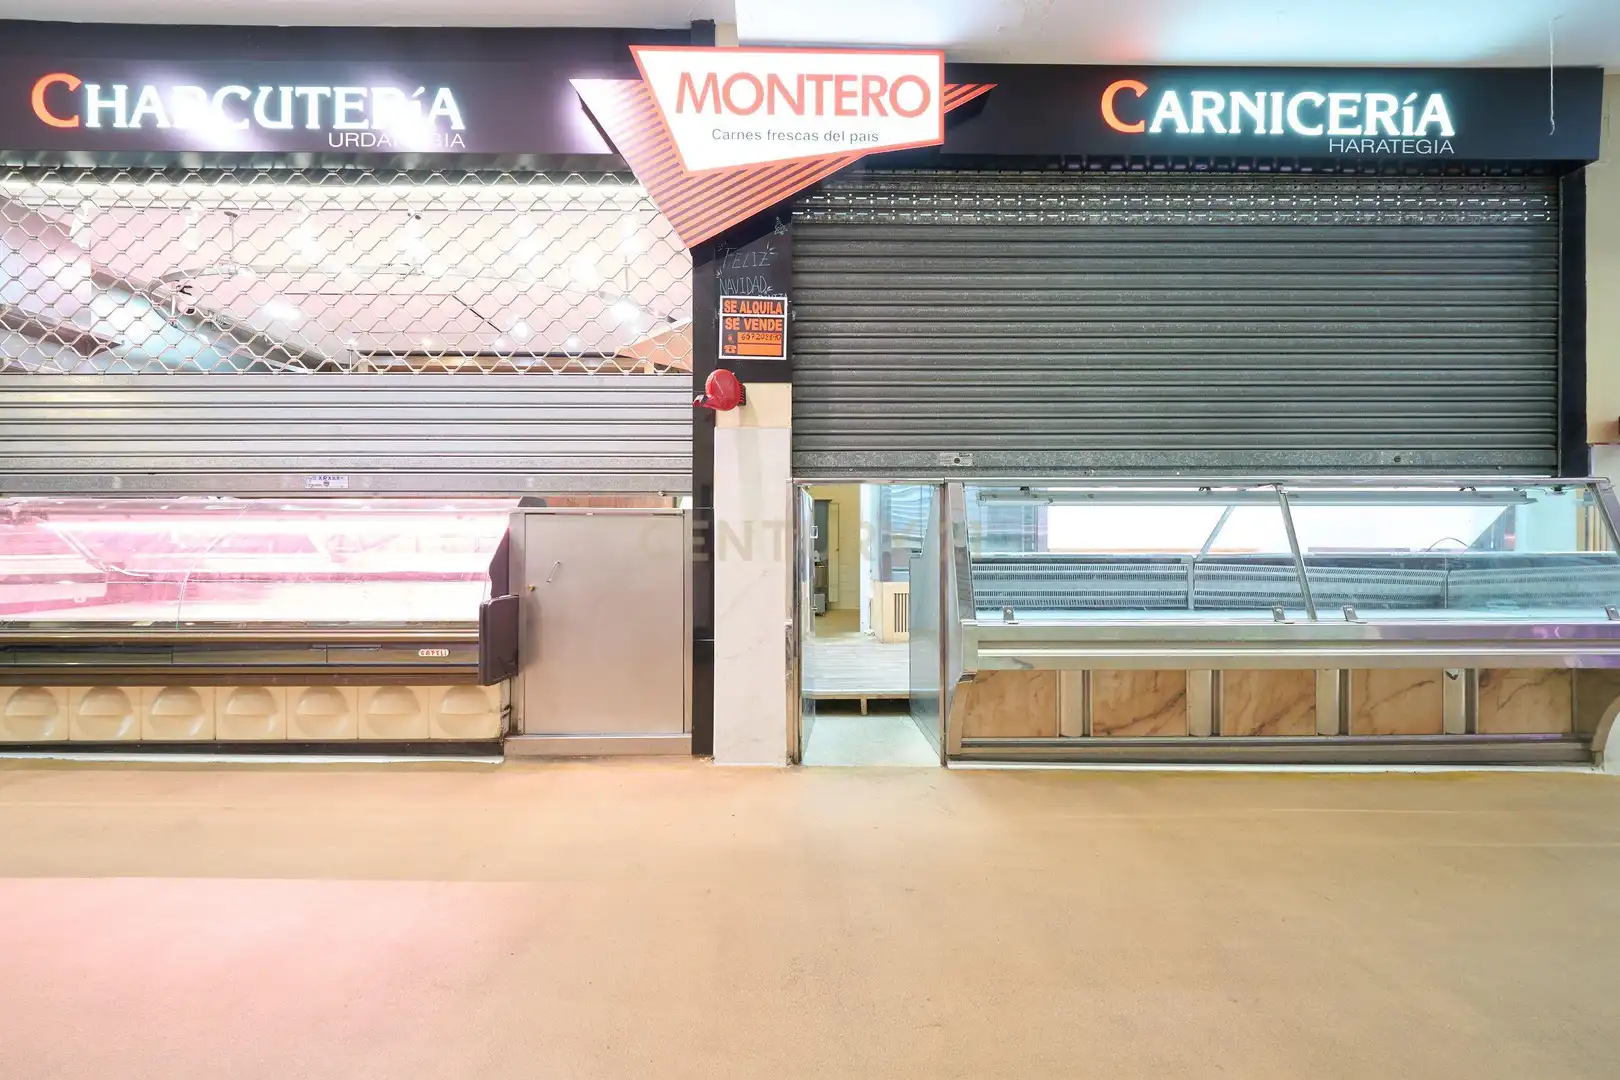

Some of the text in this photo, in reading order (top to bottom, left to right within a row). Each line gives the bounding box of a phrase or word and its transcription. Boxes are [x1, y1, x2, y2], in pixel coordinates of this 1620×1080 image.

[675, 71, 931, 118] MONTERO
[711, 128, 762, 141] Carnes
[766, 128, 819, 142] frescas
[823, 129, 845, 142] del
[1328, 138, 1455, 155] HARATEGIA
[722, 247, 771, 269] FELIZ
[719, 275, 768, 296] NAVIDAD
[723, 300, 783, 315] SE ALQUILA
[724, 317, 783, 332] SE VENDE
